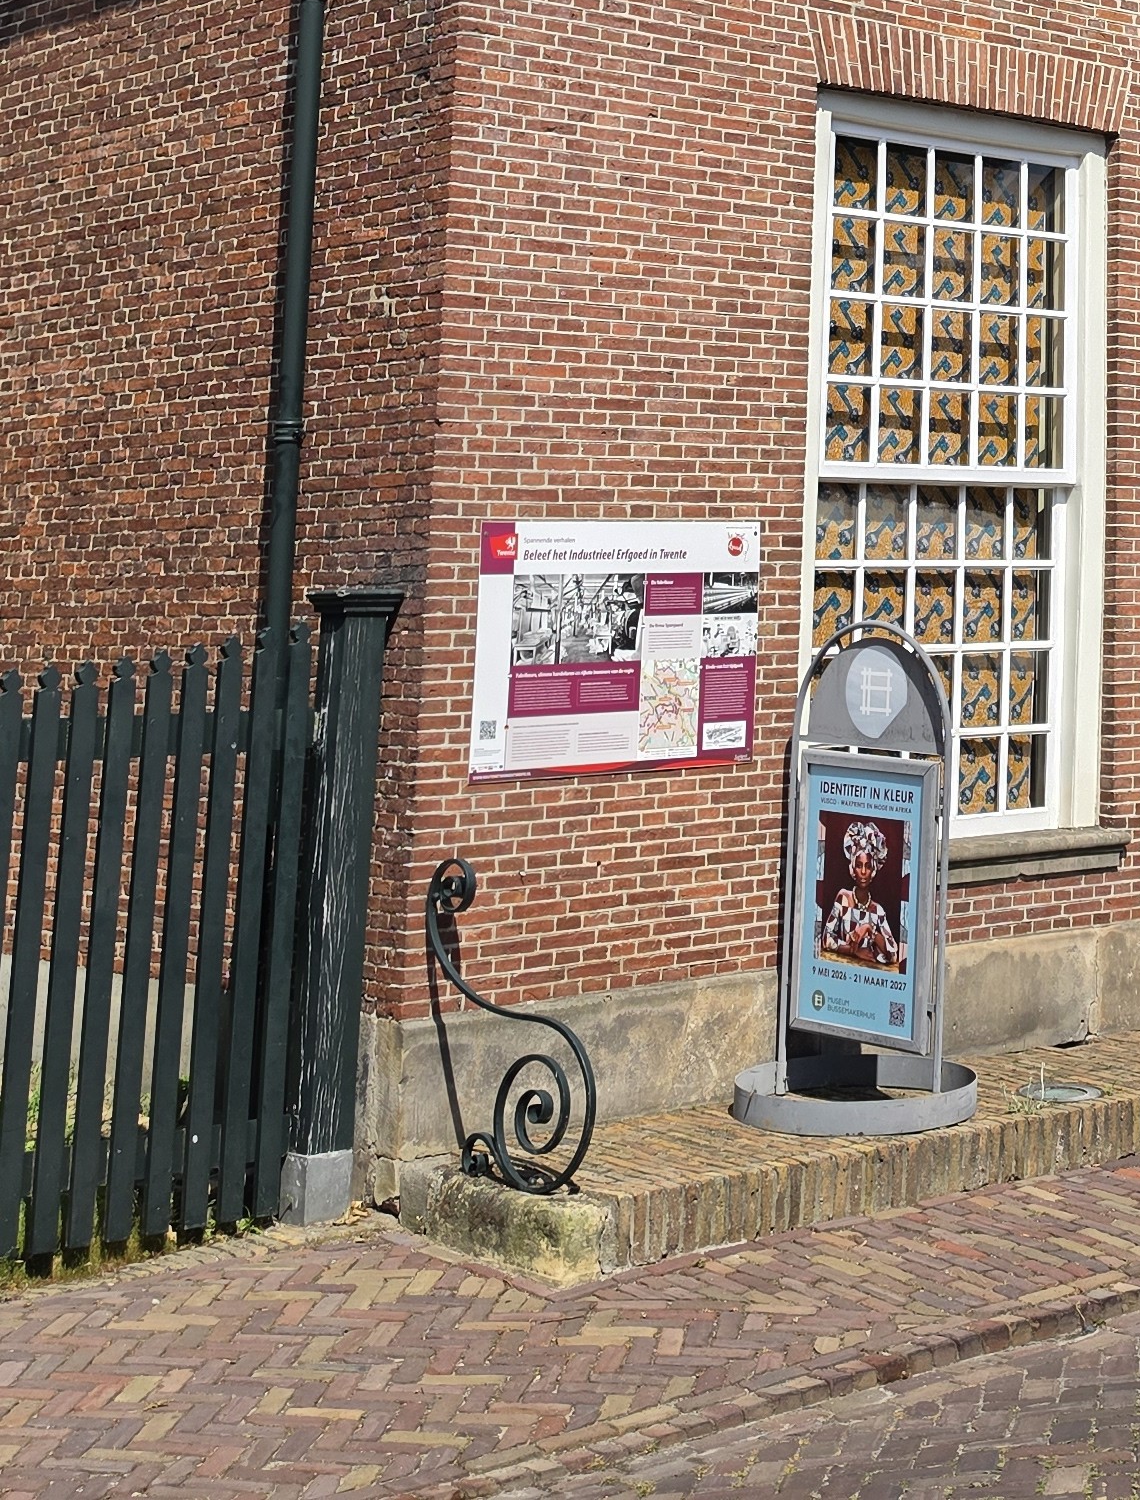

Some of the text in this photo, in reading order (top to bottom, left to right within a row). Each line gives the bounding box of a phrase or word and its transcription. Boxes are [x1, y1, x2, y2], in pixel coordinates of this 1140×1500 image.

[523, 548, 688, 562] Beleef het Industrieel Erfgoed in Twente
[820, 781, 914, 804] IDENTITEIT IN KLEUR
[818, 967, 830, 977] MEI
[831, 970, 847, 981] 2026
[854, 974, 861, 983] 21
[864, 975, 888, 988] MAART
[890, 980, 907, 991] 2027
[827, 996, 850, 1007] MUSEUM
[827, 1004, 876, 1021] BUSSEMAKERHUIS
